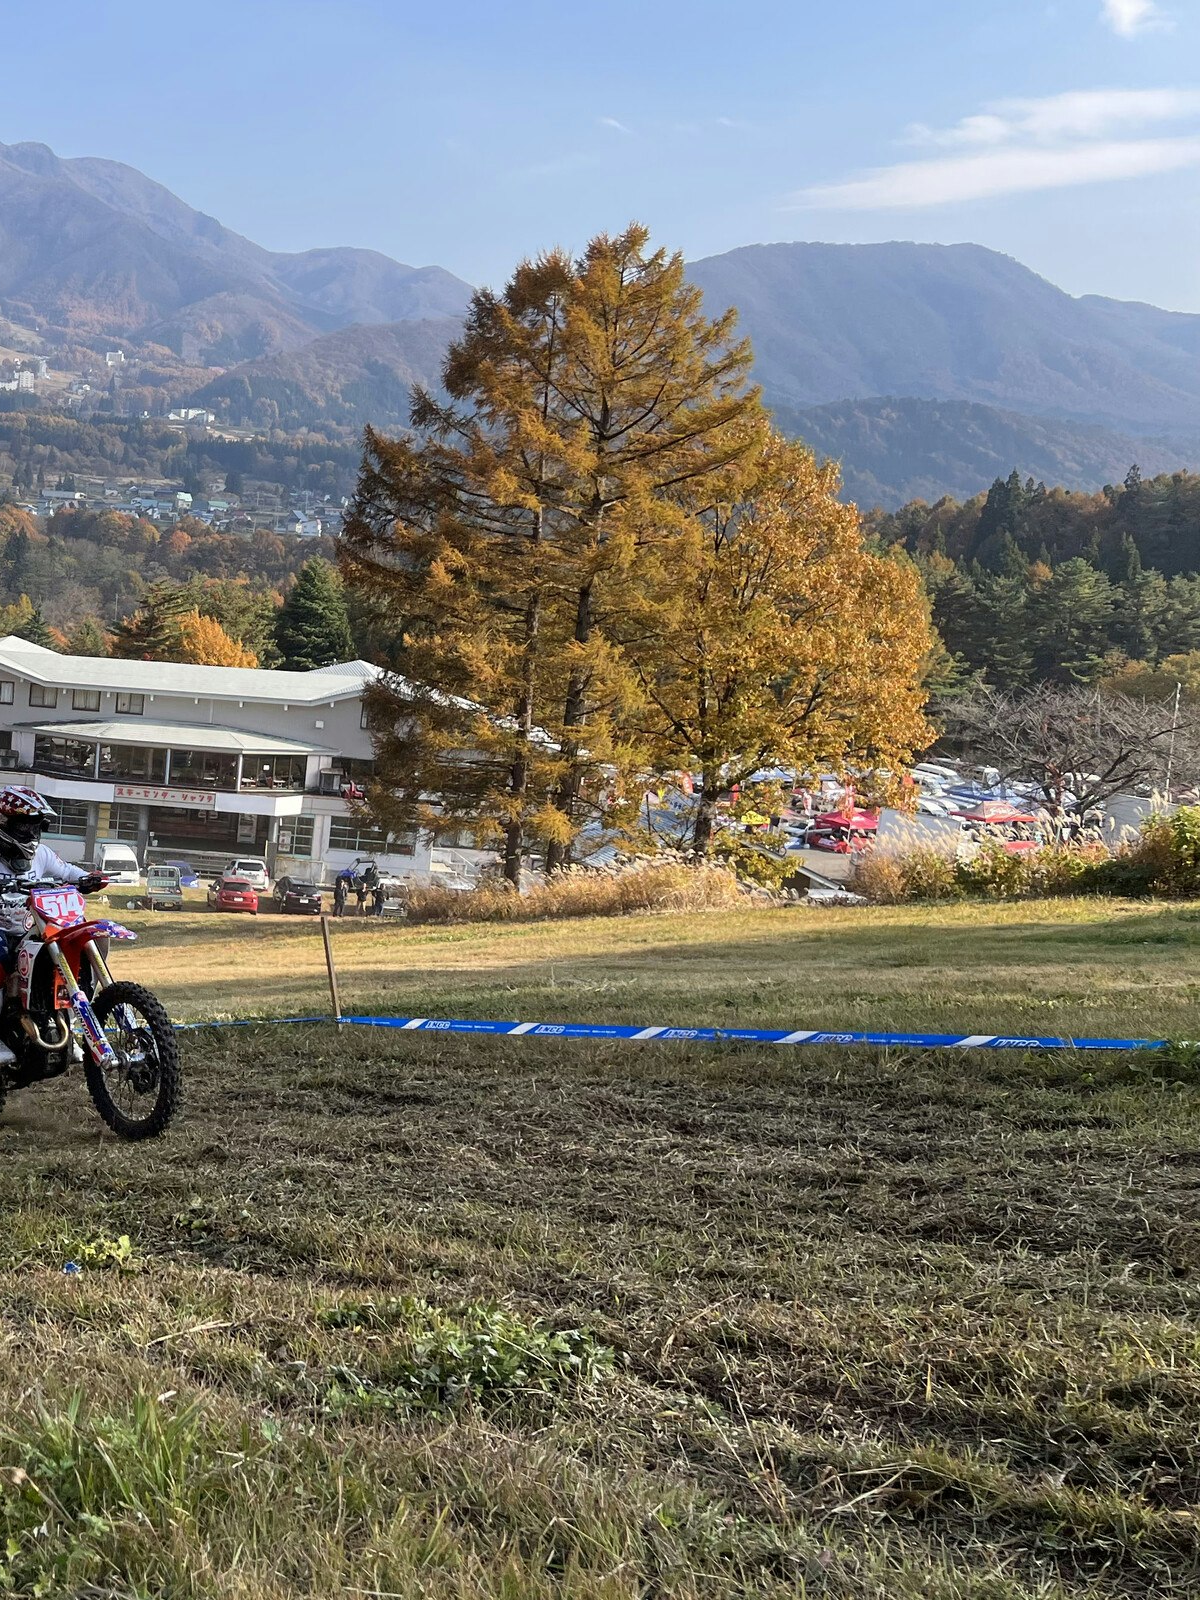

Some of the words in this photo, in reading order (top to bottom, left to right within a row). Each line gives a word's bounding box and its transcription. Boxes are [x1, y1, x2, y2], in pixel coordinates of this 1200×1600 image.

[116, 787, 176, 800] スキーセンター
[42, 893, 84, 918] 514
[73, 1006, 93, 1041] DUNLOP
